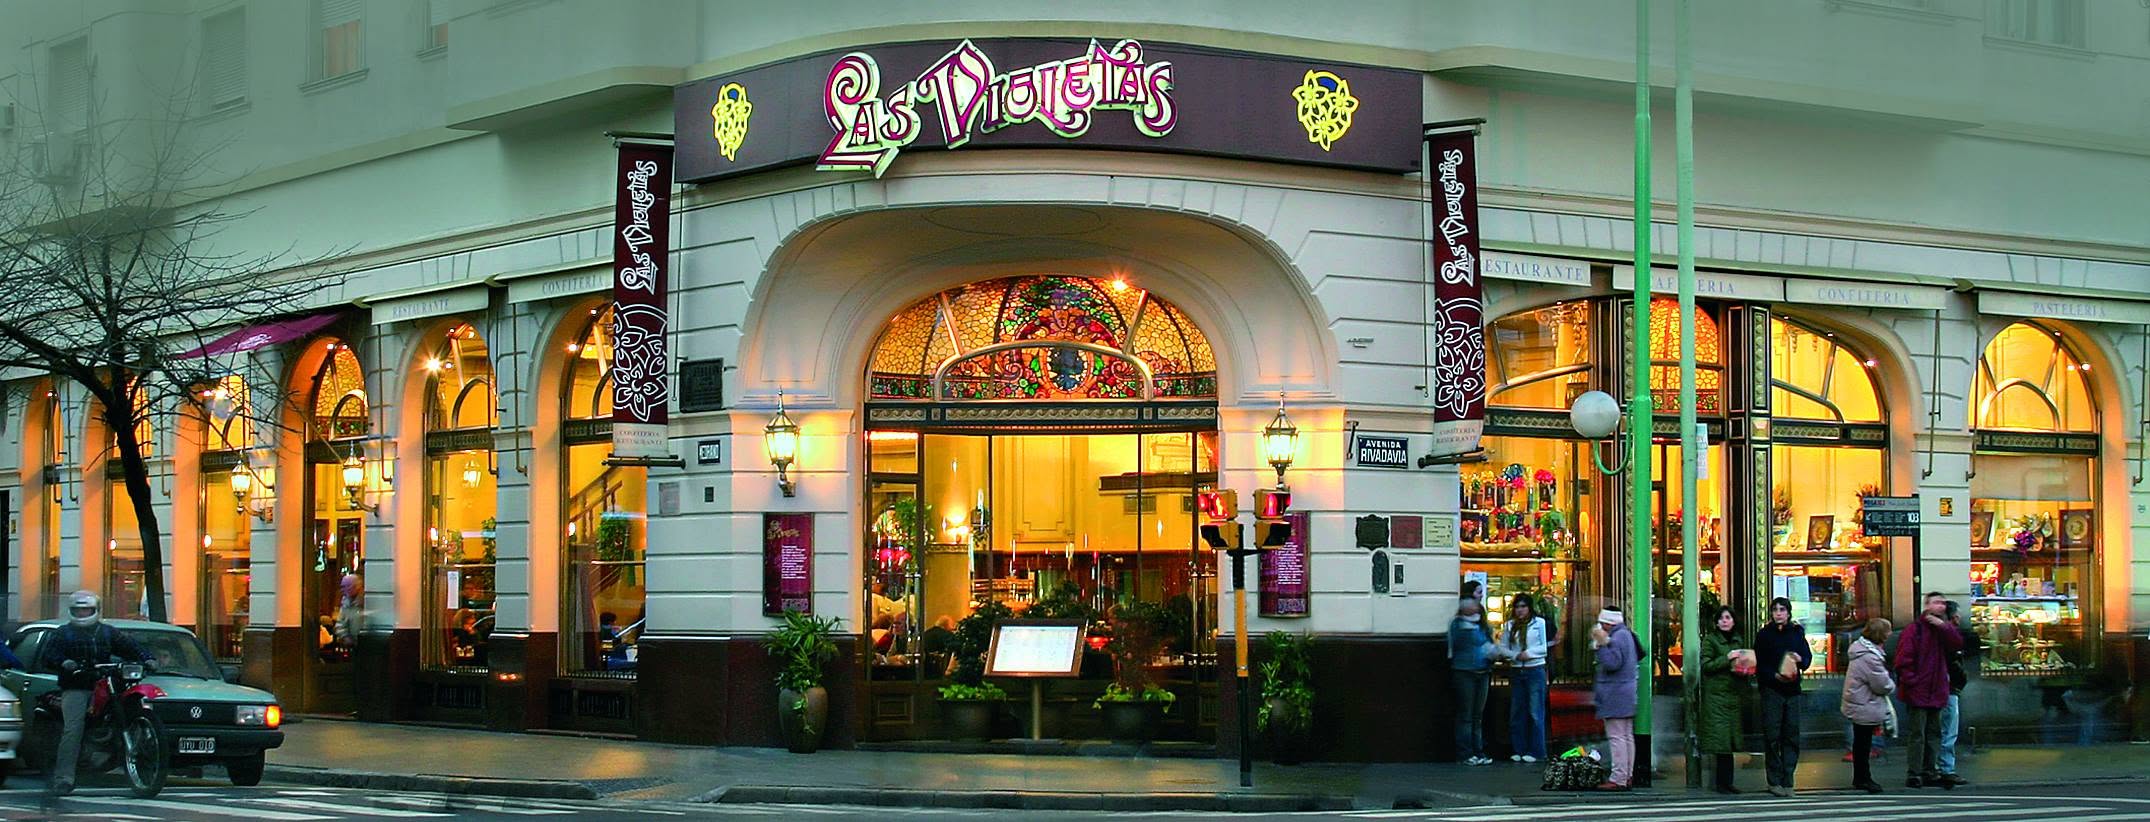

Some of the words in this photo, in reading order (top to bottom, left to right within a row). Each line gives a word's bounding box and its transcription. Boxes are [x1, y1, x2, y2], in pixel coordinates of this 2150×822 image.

[1485, 258, 1584, 281] ESTAURANTE
[542, 273, 606, 294] CONFITERIA
[1650, 275, 1735, 294] AFERIA
[1817, 287, 1912, 305] CONFITERIA
[392, 298, 449, 318] RESTAURANTE
[2032, 302, 2106, 317] PASTELERIA
[1365, 440, 1402, 449] AVENIDA
[1360, 448, 1407, 464] RIVADAVIA
